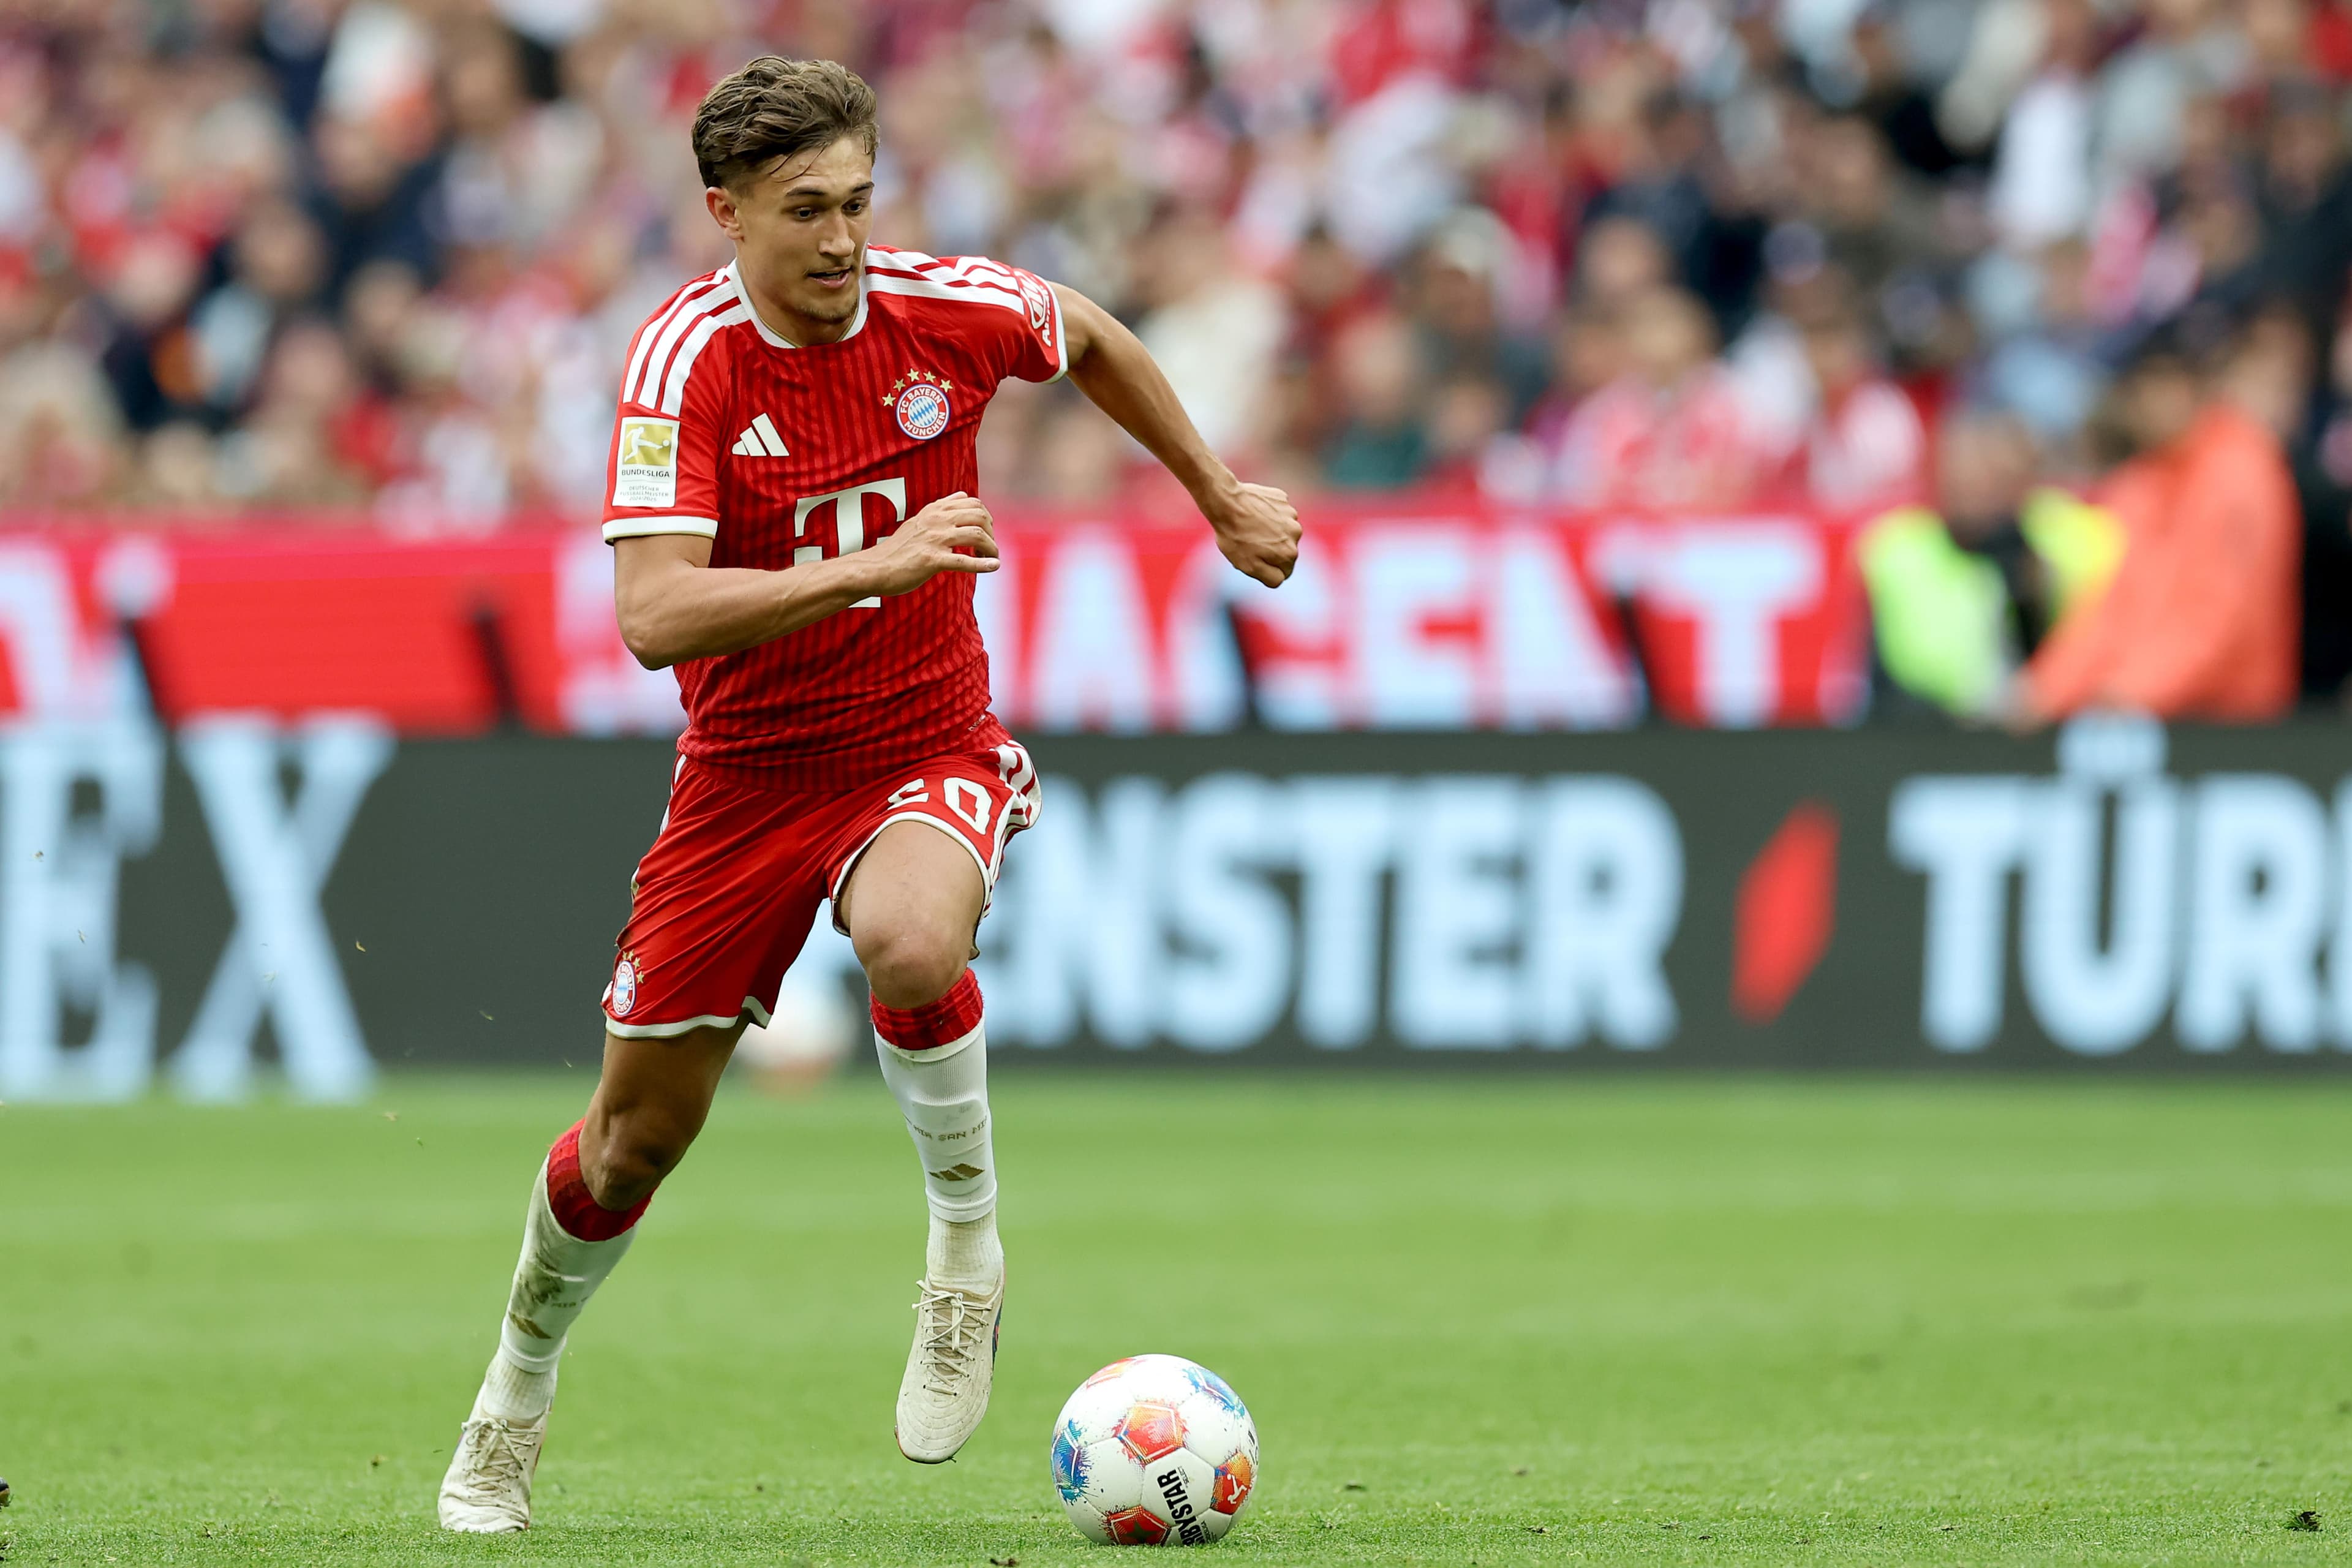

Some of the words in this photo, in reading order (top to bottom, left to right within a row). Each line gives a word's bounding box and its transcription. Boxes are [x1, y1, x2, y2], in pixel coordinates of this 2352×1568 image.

[900, 400, 909, 413] FC
[907, 388, 942, 404] BAYERN
[622, 469, 670, 478] BUNDESLIGA
[938, 1131, 966, 1141] SAN
